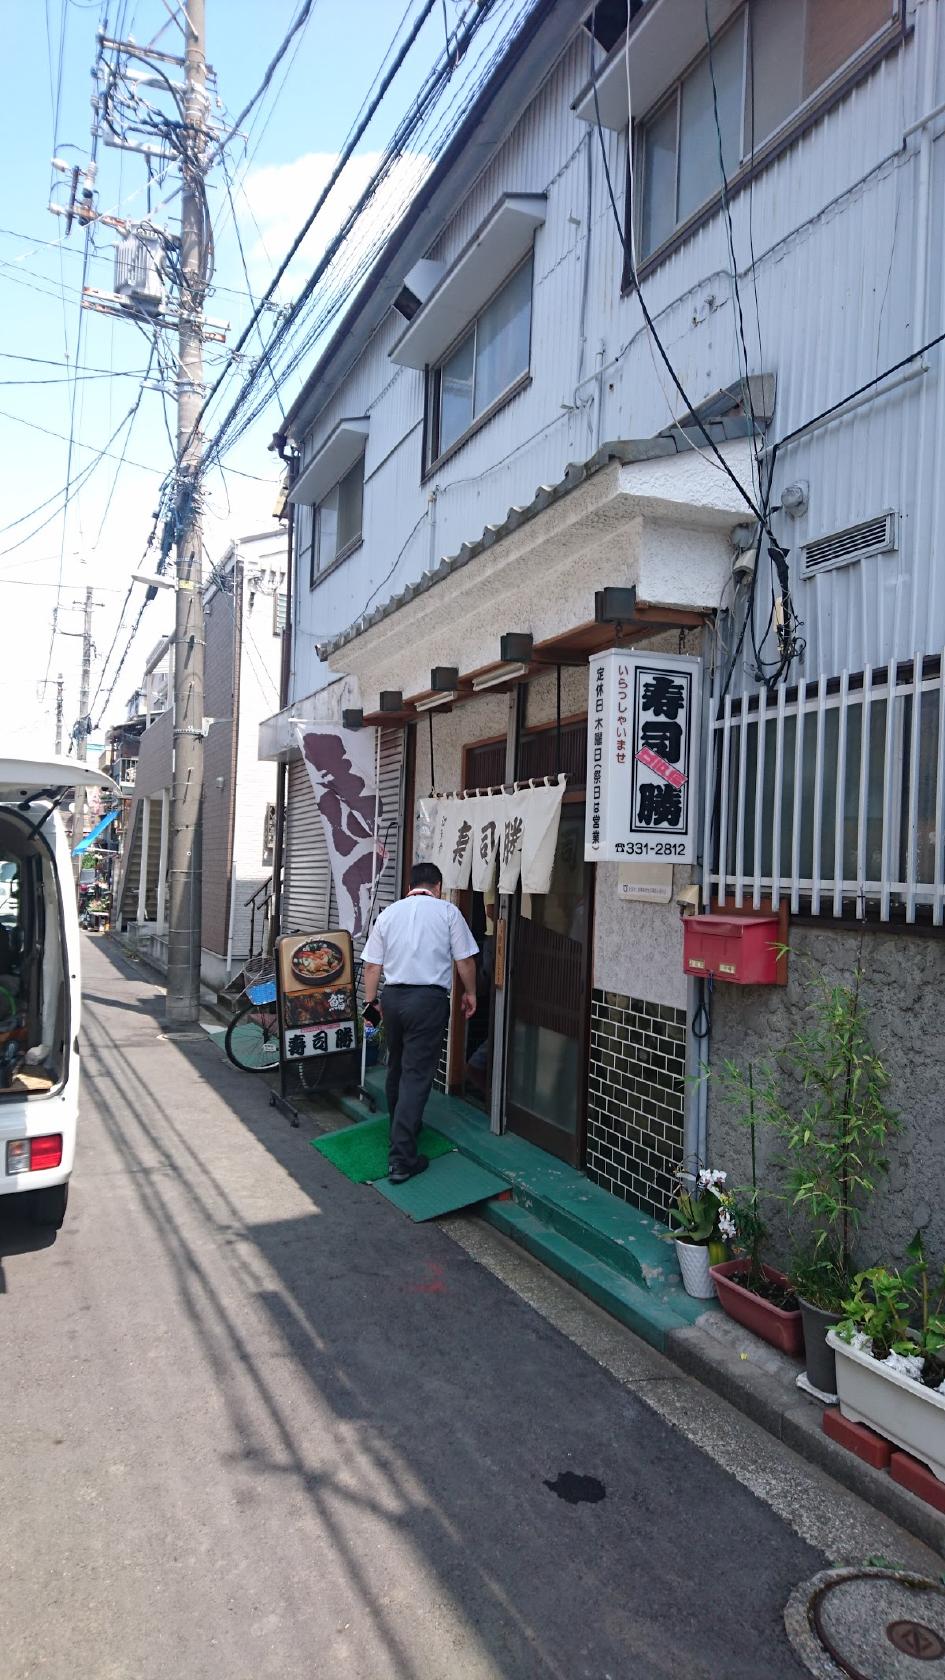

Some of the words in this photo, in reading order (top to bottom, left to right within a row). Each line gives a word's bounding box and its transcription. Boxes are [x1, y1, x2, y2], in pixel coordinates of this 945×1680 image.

[596, 667, 605, 712] 定休日
[615, 665, 629, 764] いらっしゃいませ
[638, 677, 685, 826] 寿司勝
[453, 817, 523, 866] 寿司勝
[625, 842, 686, 856] 331-2812
[288, 1027, 353, 1056] 寿司勝
